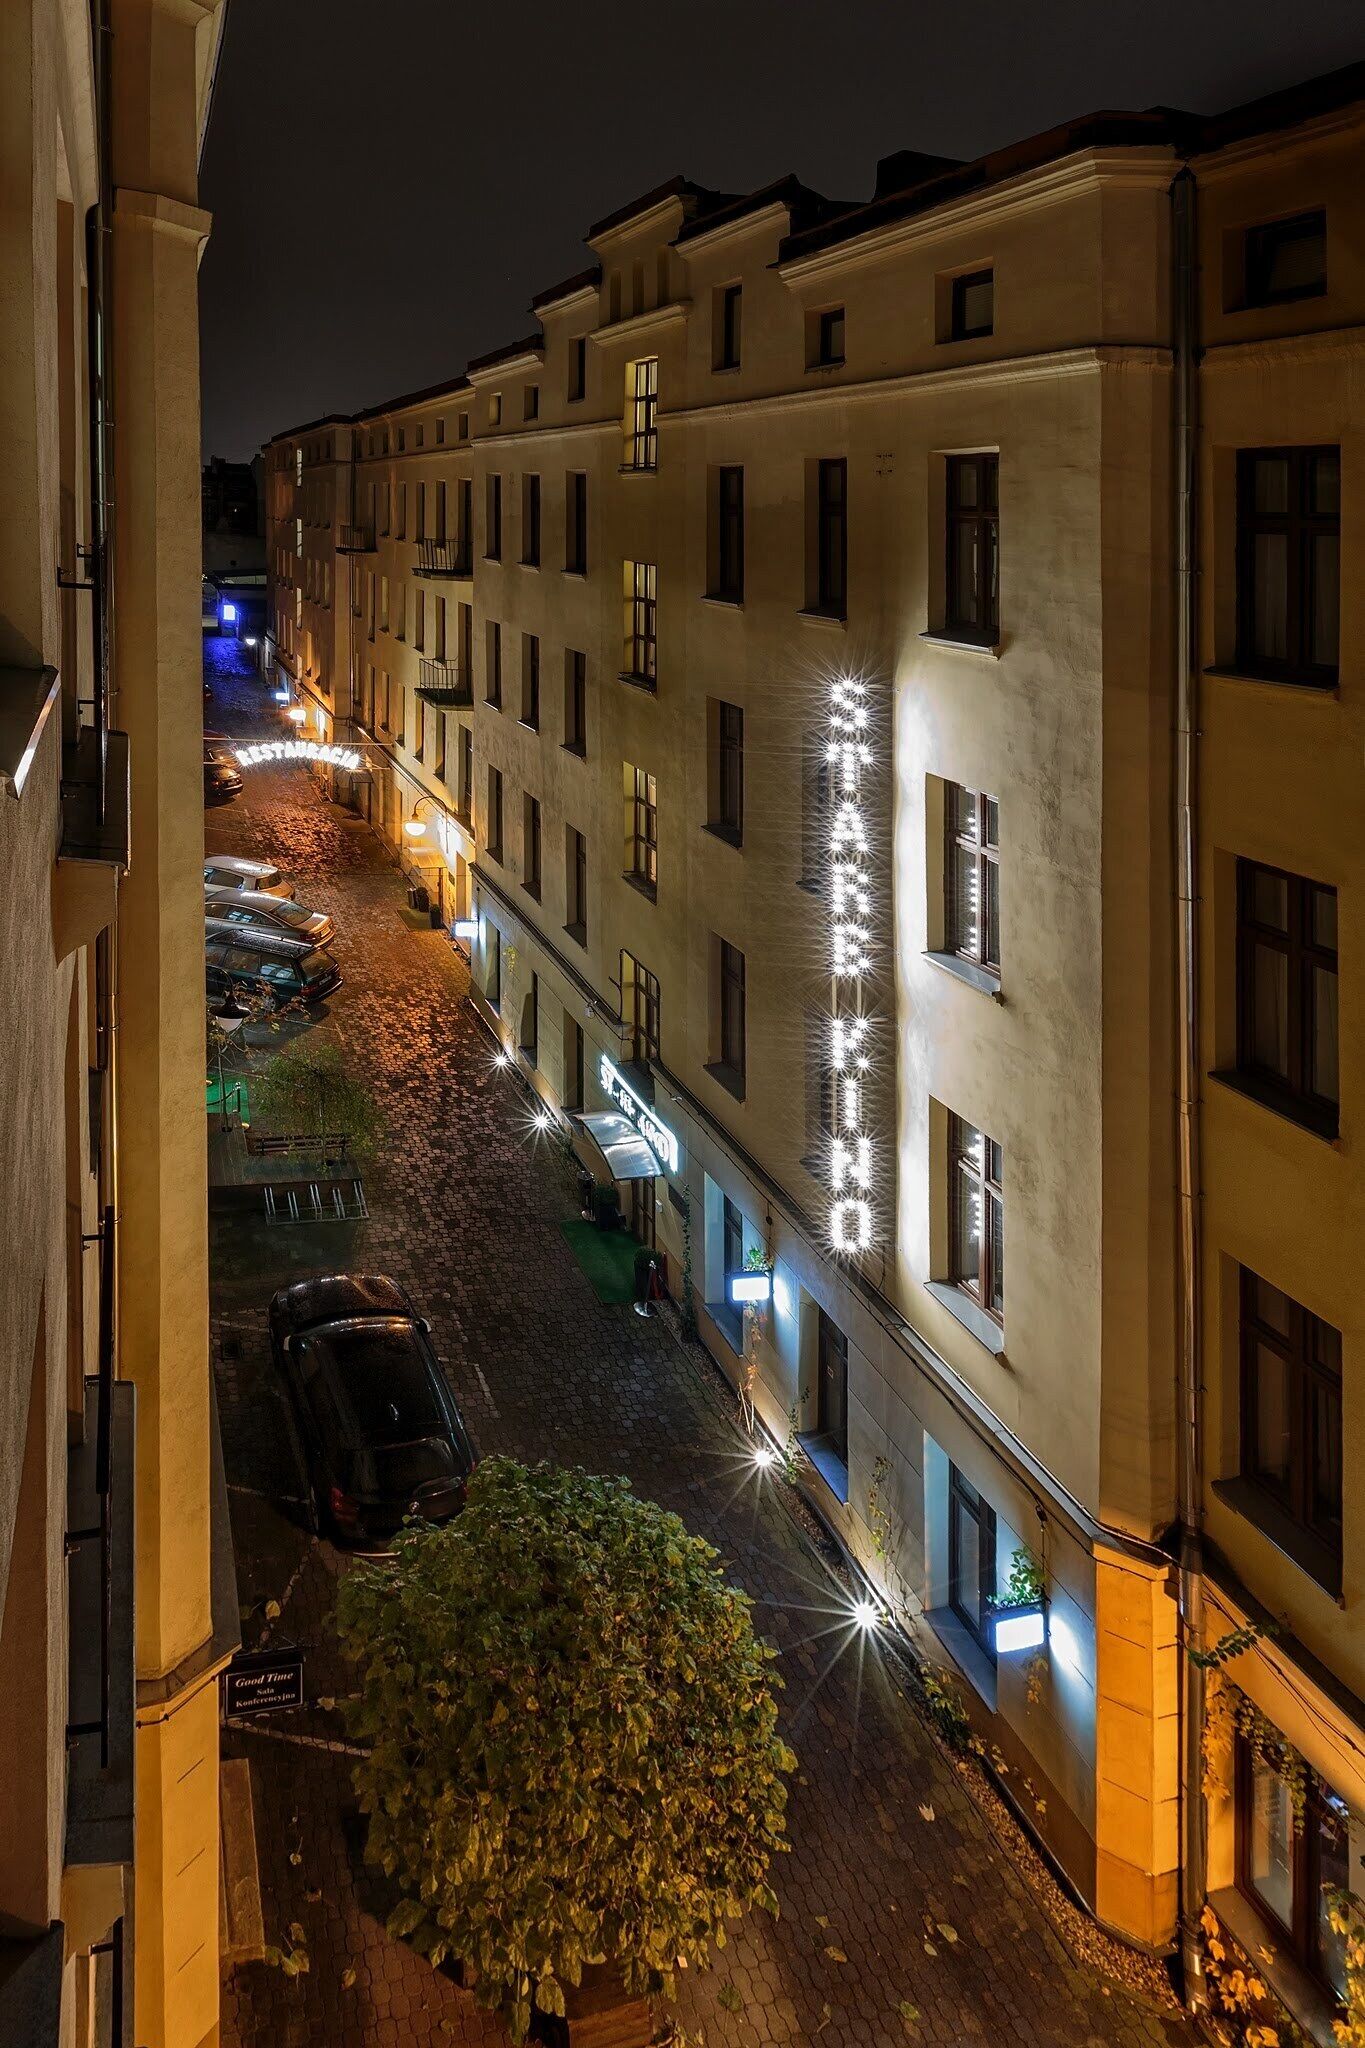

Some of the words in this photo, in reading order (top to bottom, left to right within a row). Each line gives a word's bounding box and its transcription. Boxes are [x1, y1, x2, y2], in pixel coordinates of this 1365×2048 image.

[827, 678, 872, 976] STARE
[830, 1018, 873, 1253] KINO
[235, 1675, 264, 1688] Good
[266, 1672, 294, 1683] Time
[235, 1692, 296, 1708] Konferencyjna
